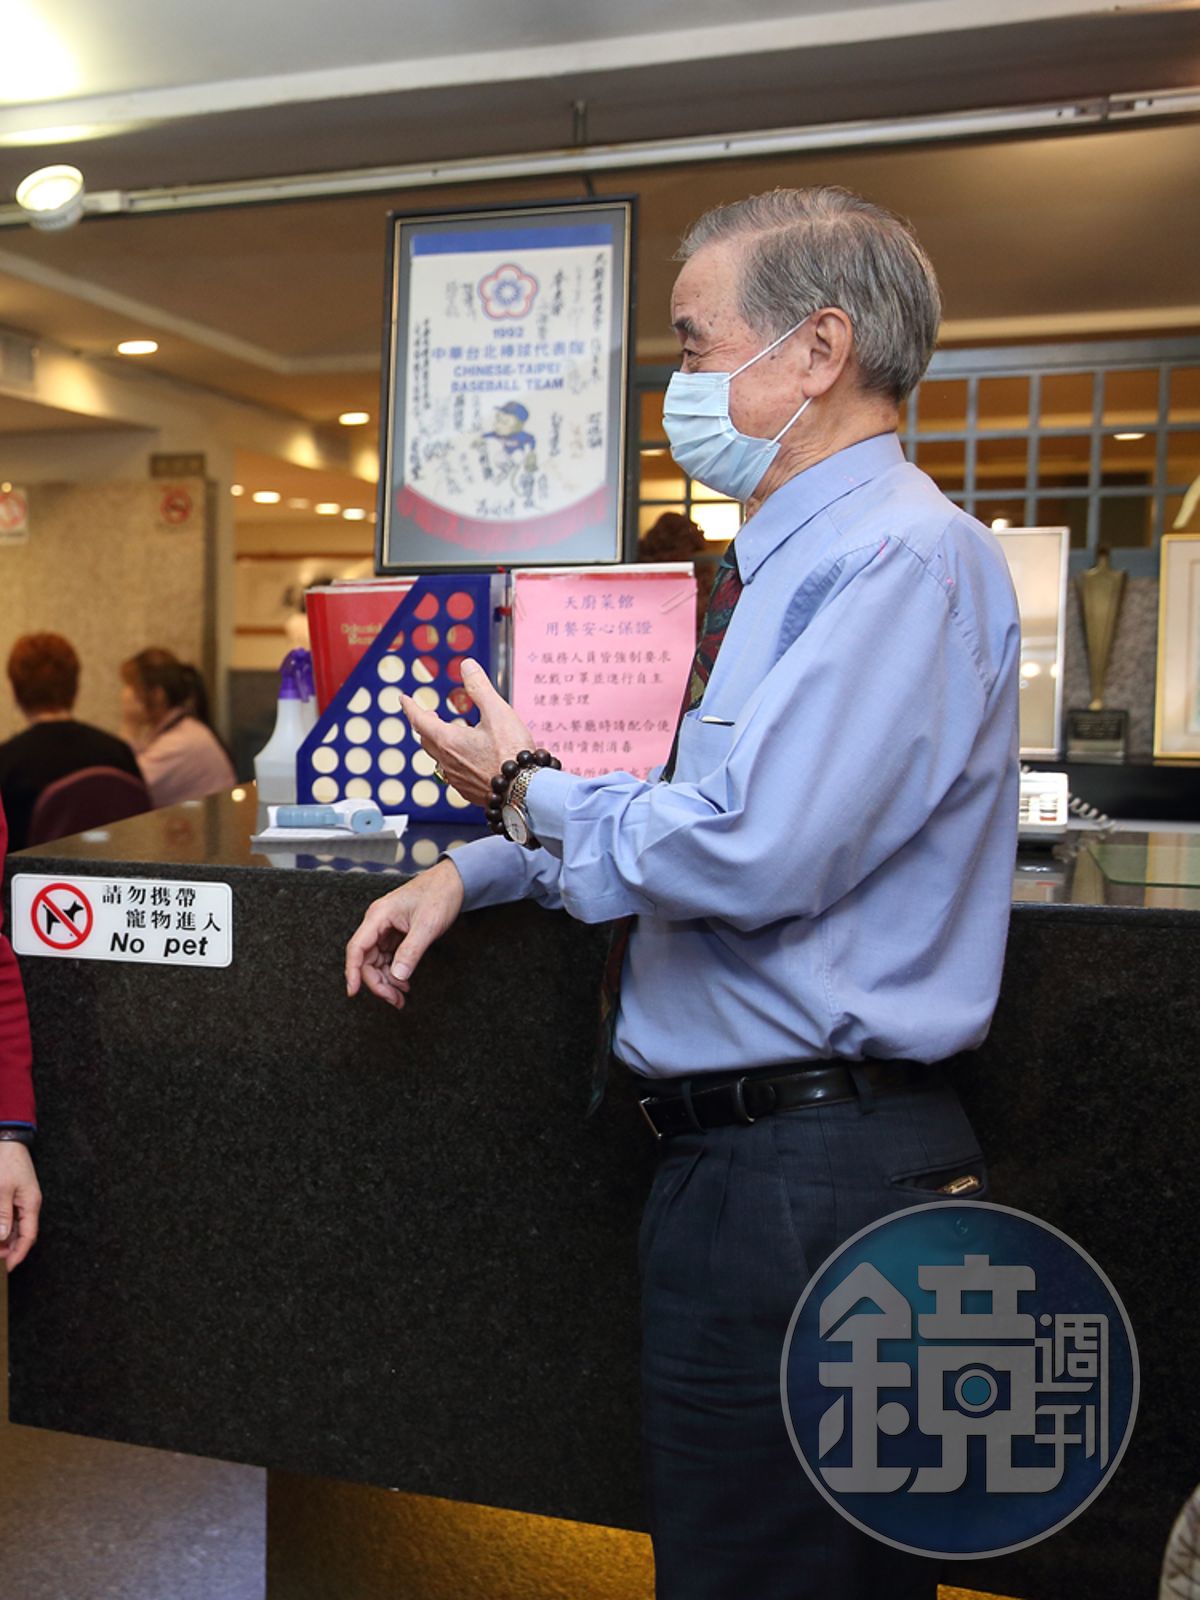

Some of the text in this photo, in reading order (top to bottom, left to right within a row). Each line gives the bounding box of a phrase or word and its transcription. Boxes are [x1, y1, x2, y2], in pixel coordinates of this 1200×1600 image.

[493, 326, 524, 338] 1992
[432, 341, 585, 360] 中華台北棒球代表隊
[450, 377, 564, 393] BASEBALL TEAM
[565, 594, 635, 610] 天廚菜館
[545, 621, 653, 636] 用餐安心保證
[541, 650, 672, 664] 服務人員皆強制要求
[534, 693, 590, 706] 健康管理
[541, 719, 671, 732] 進入餐廳時請配合使
[110, 932, 208, 957] No pet
